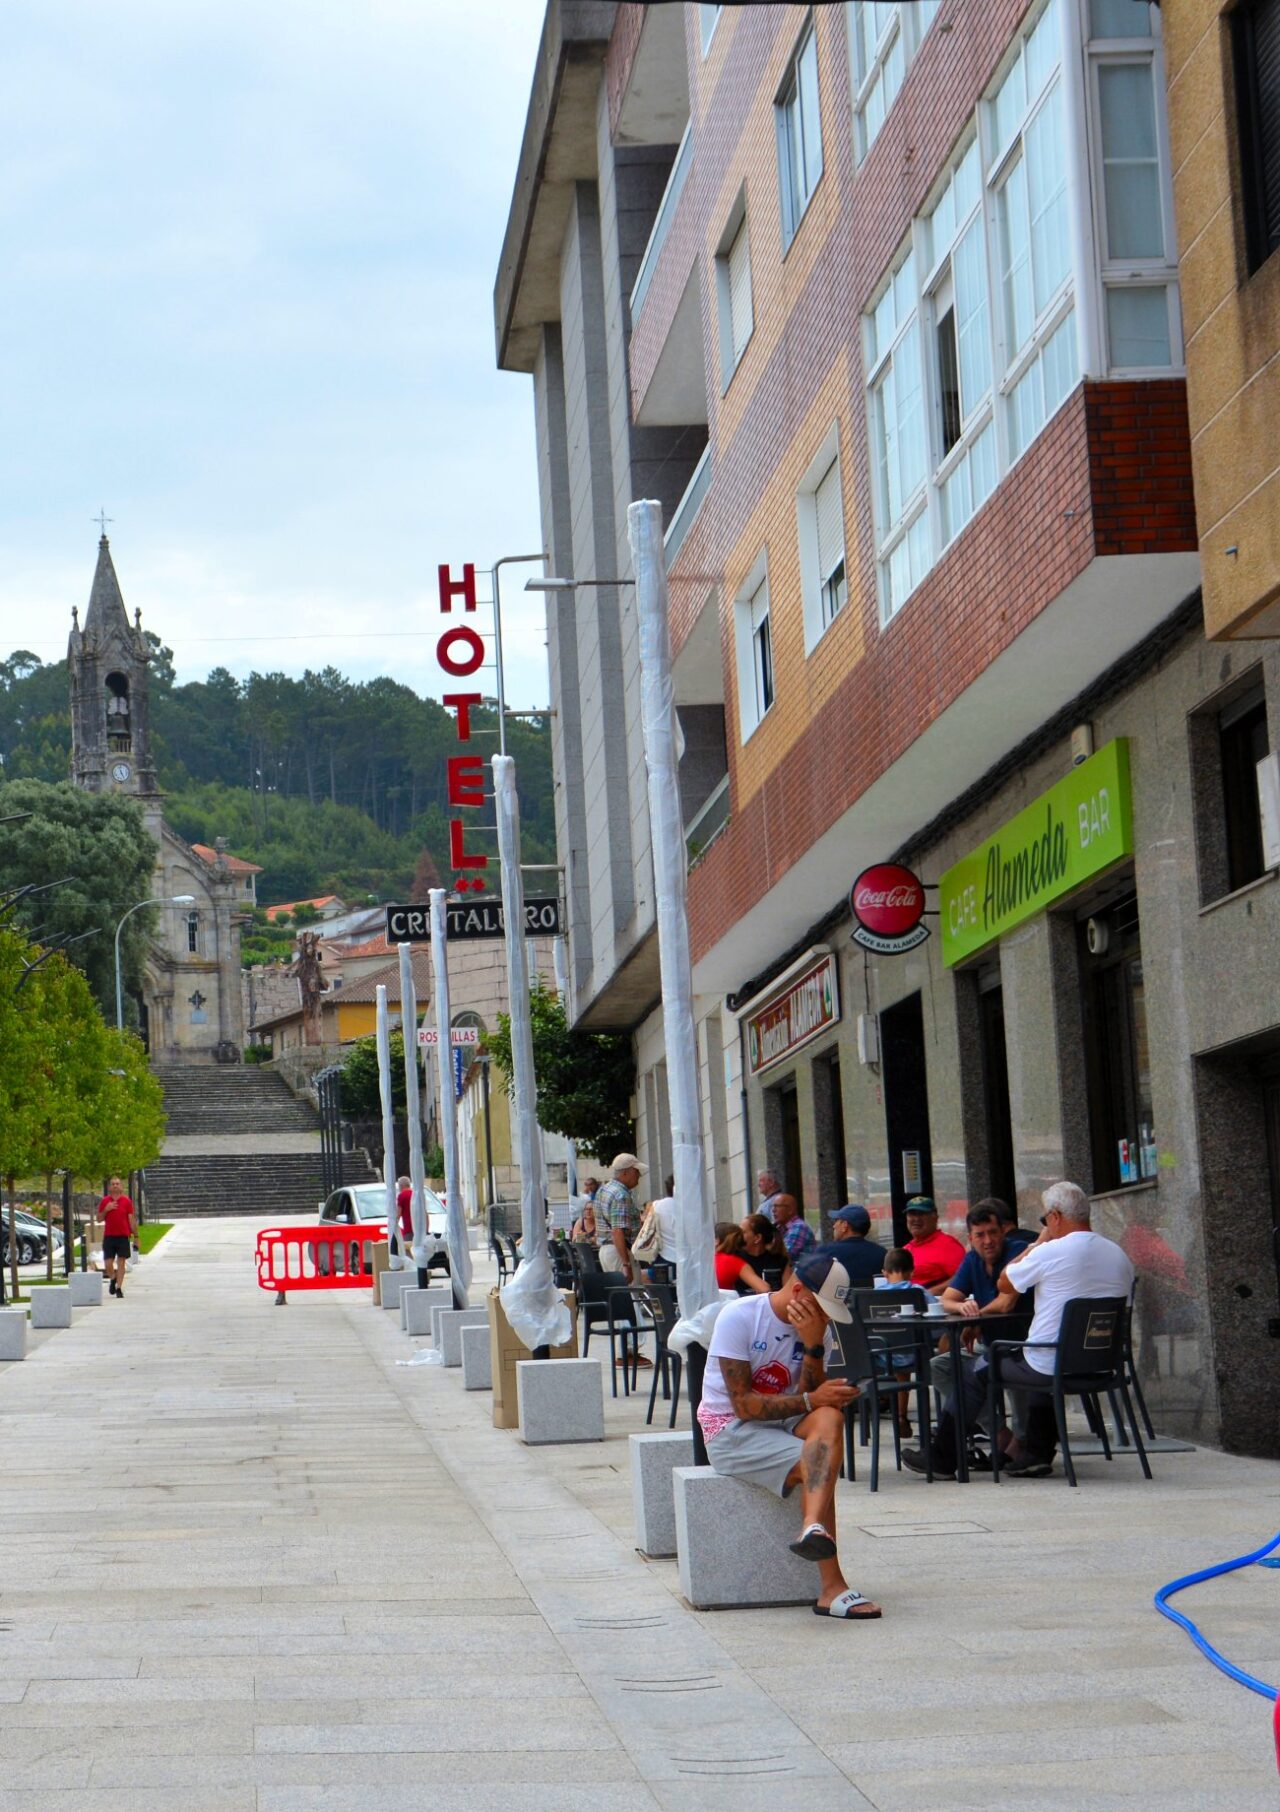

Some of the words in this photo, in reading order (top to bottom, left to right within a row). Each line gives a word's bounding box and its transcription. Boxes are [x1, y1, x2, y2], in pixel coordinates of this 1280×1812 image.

[436, 563, 488, 870] HOTEL
[983, 803, 1069, 931] Alameda
[1078, 787, 1111, 849] BAR
[855, 885, 918, 909] Coca-Cola
[391, 904, 556, 936] CRITALRO
[876, 941, 891, 949] BAR
[892, 930, 926, 949] ALAMEDA
[419, 1030, 476, 1043] ROSILLAS
